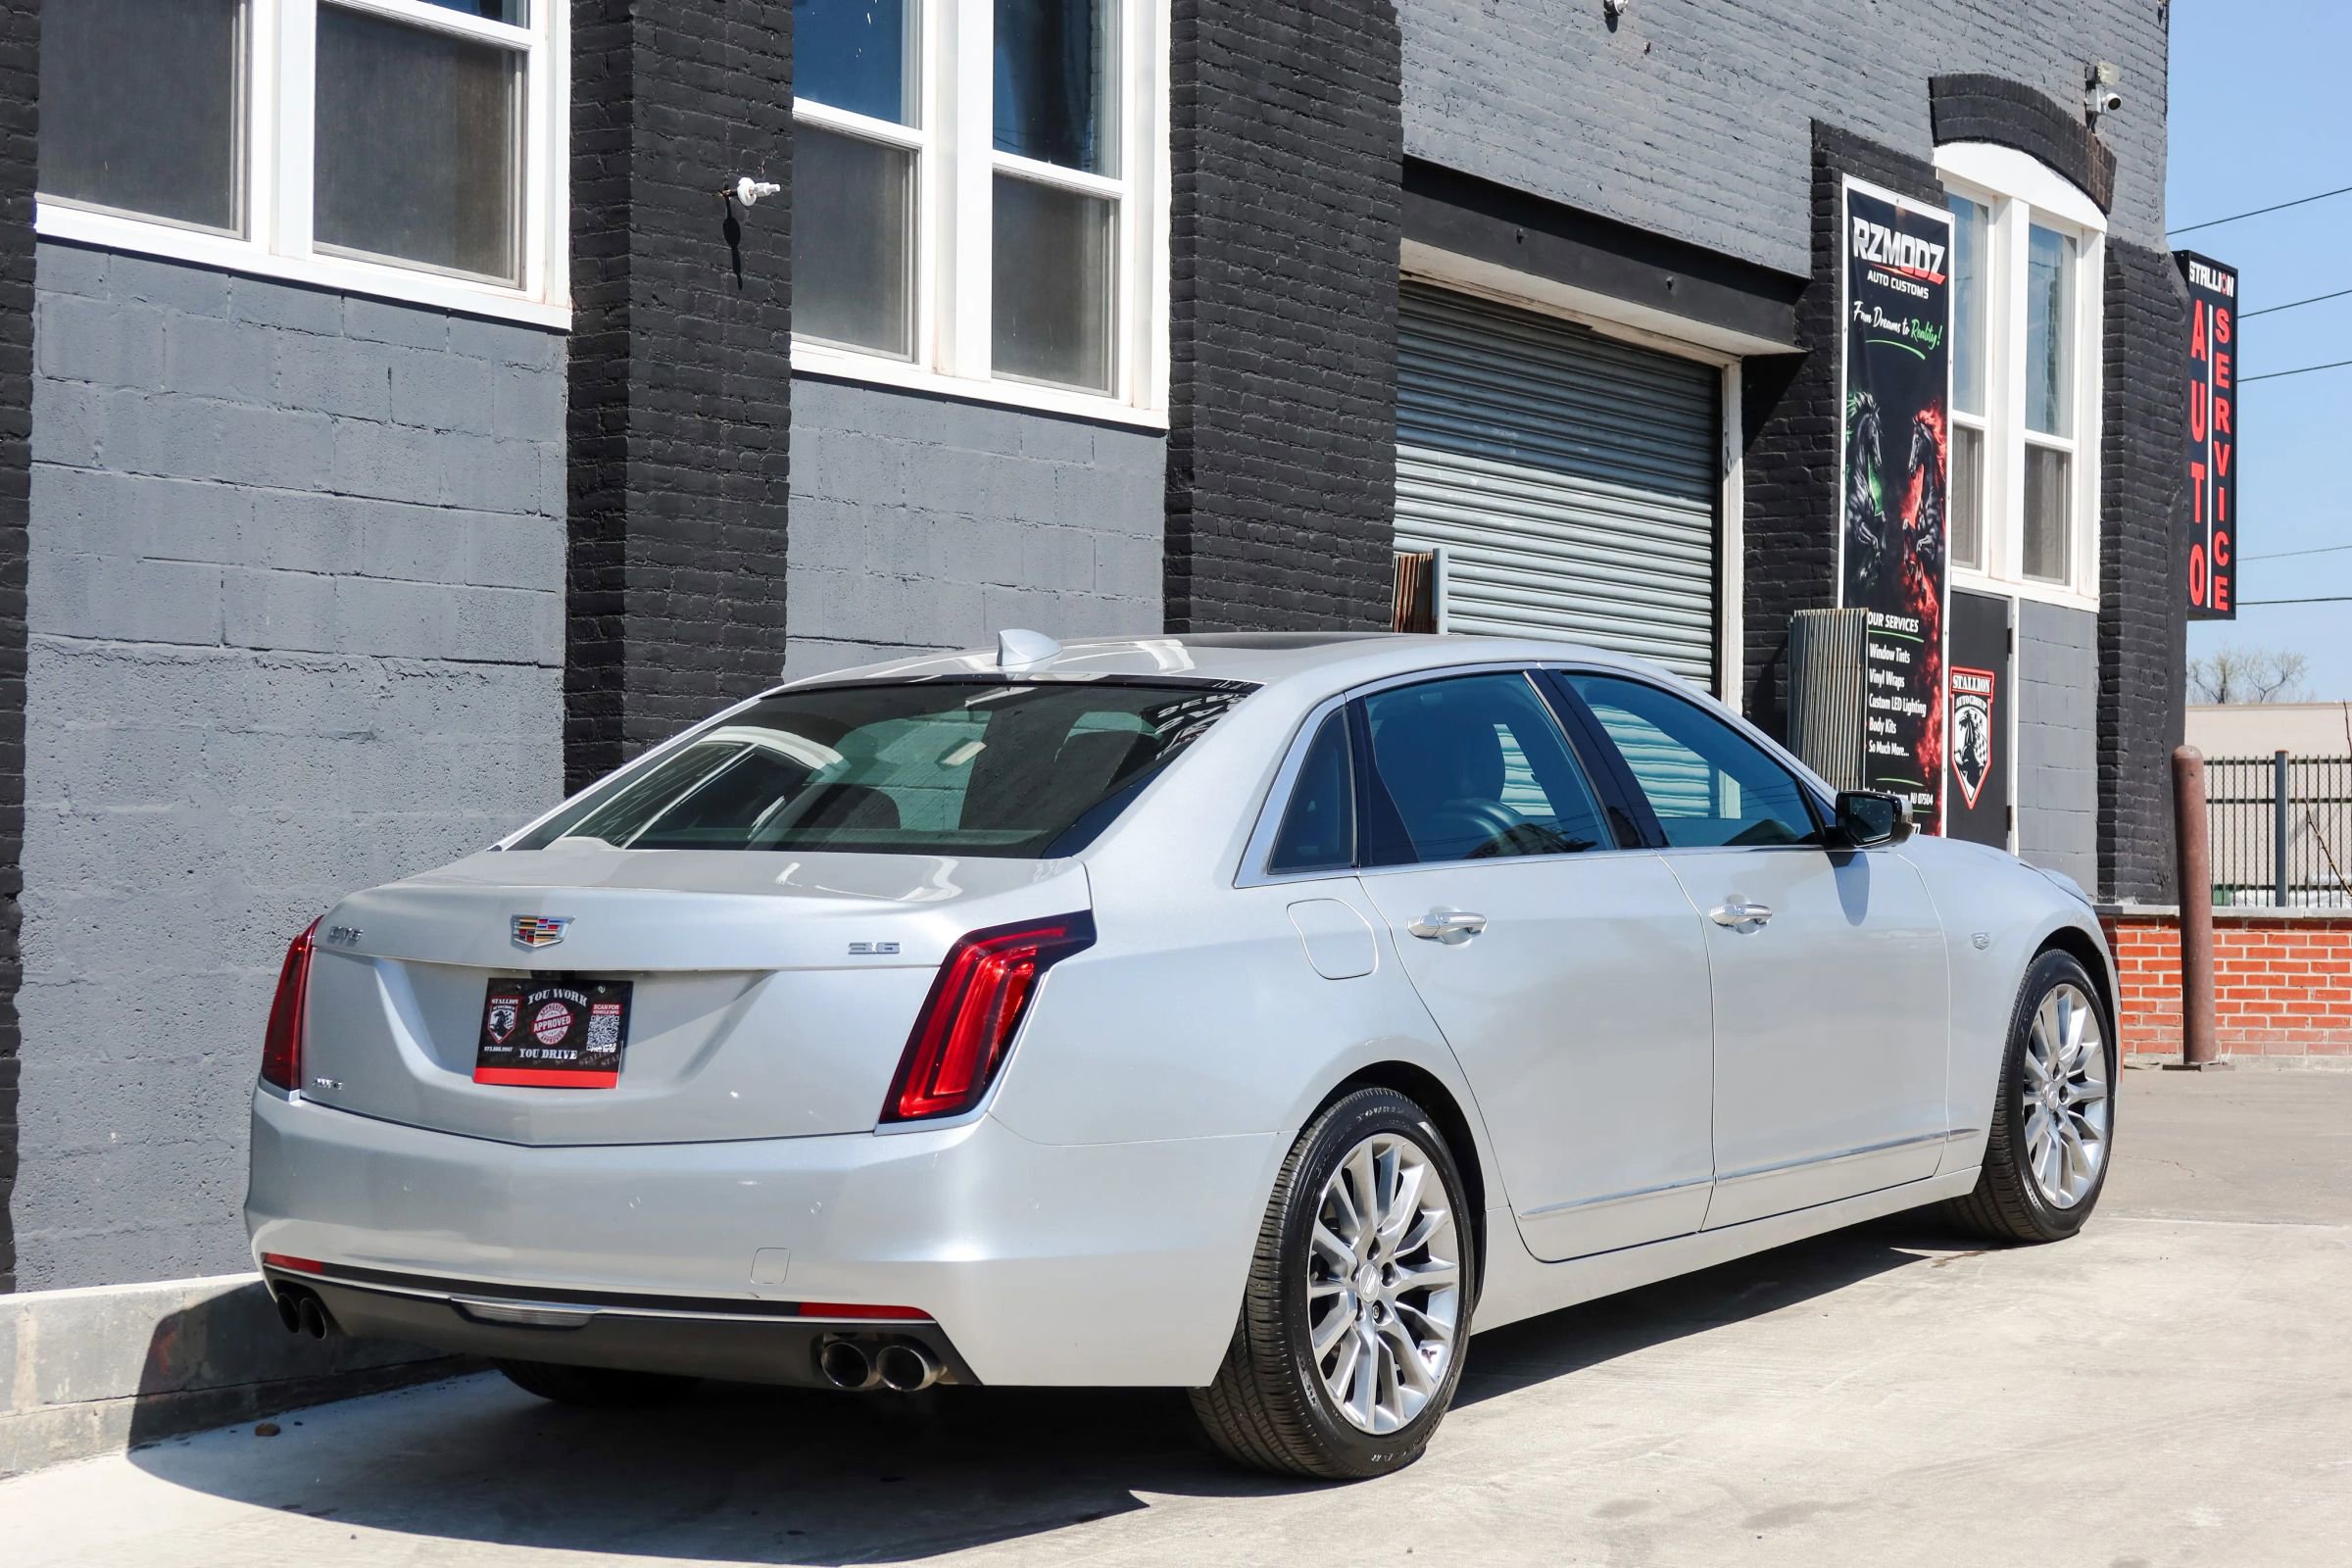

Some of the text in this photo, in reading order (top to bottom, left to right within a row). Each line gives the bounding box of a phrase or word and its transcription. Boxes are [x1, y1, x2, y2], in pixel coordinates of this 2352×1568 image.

[1853, 216, 1945, 285] RZMODZ
[1867, 270, 1930, 299] AUTO CUSTOMS
[2189, 260, 2234, 298] STALLION
[1853, 300, 1943, 351] From Dreams to Reality!
[2189, 299, 2207, 607] AUTO
[2213, 308, 2231, 612] SERVICE
[1867, 611, 1920, 633] OUR SERVICES
[1869, 643, 1911, 663] Window Tints
[1869, 667, 1905, 691] Vinyl Wraps
[1952, 674, 1991, 693] STALLION
[1868, 693, 1927, 717] Custom LED Lighting
[1869, 716, 1897, 736] Body Kits
[1868, 739, 1876, 754] So
[1876, 740, 1890, 755] Much
[527, 988, 588, 1008] YOU WORK
[533, 1015, 571, 1033] APPROVED
[518, 1049, 540, 1058] YOU
[540, 1049, 578, 1060] DRIVE
